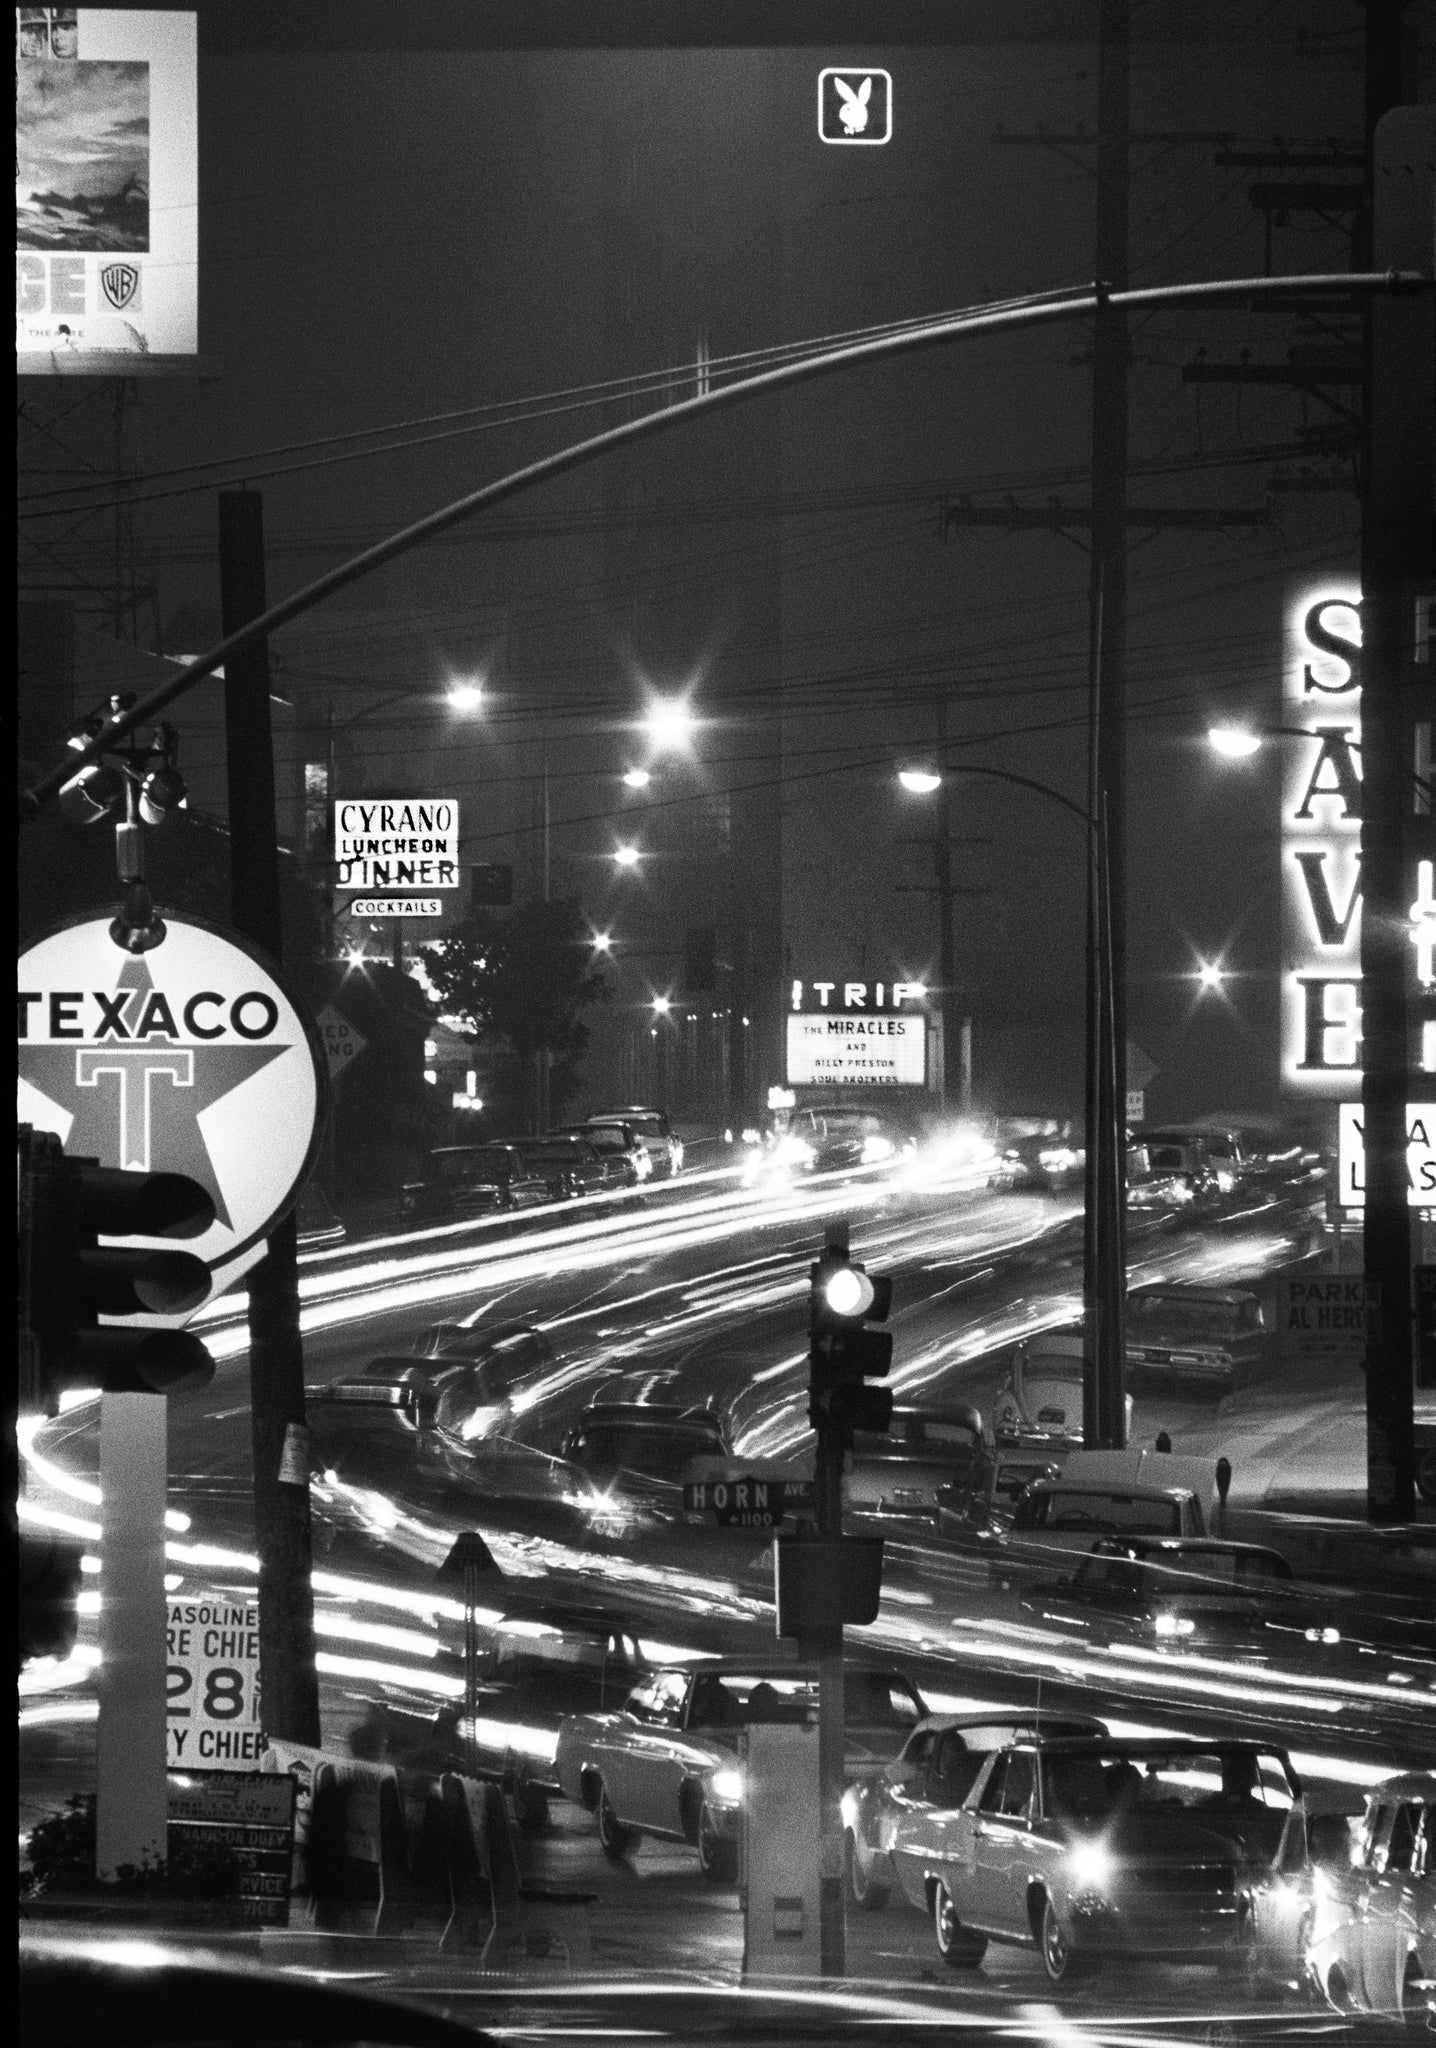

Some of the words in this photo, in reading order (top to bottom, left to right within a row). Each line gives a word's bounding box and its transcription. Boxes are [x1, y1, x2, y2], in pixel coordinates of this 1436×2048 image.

[341, 805, 452, 833] CYRANO
[342, 839, 448, 855] LUNCHEON
[337, 860, 455, 885] DINNER
[355, 902, 438, 913] COCKTAILS
[813, 982, 922, 1007] TRIP
[18, 991, 279, 1040] TEXACO
[827, 1021, 906, 1036] MIRACLES
[846, 1043, 867, 1051] AND
[847, 1060, 895, 1068] PRESTON
[692, 1484, 768, 1509] HORN
[742, 1512, 773, 1527] 1100
[166, 1606, 257, 1626] ASOLINE
[248, 1830, 286, 1847] DUTY
